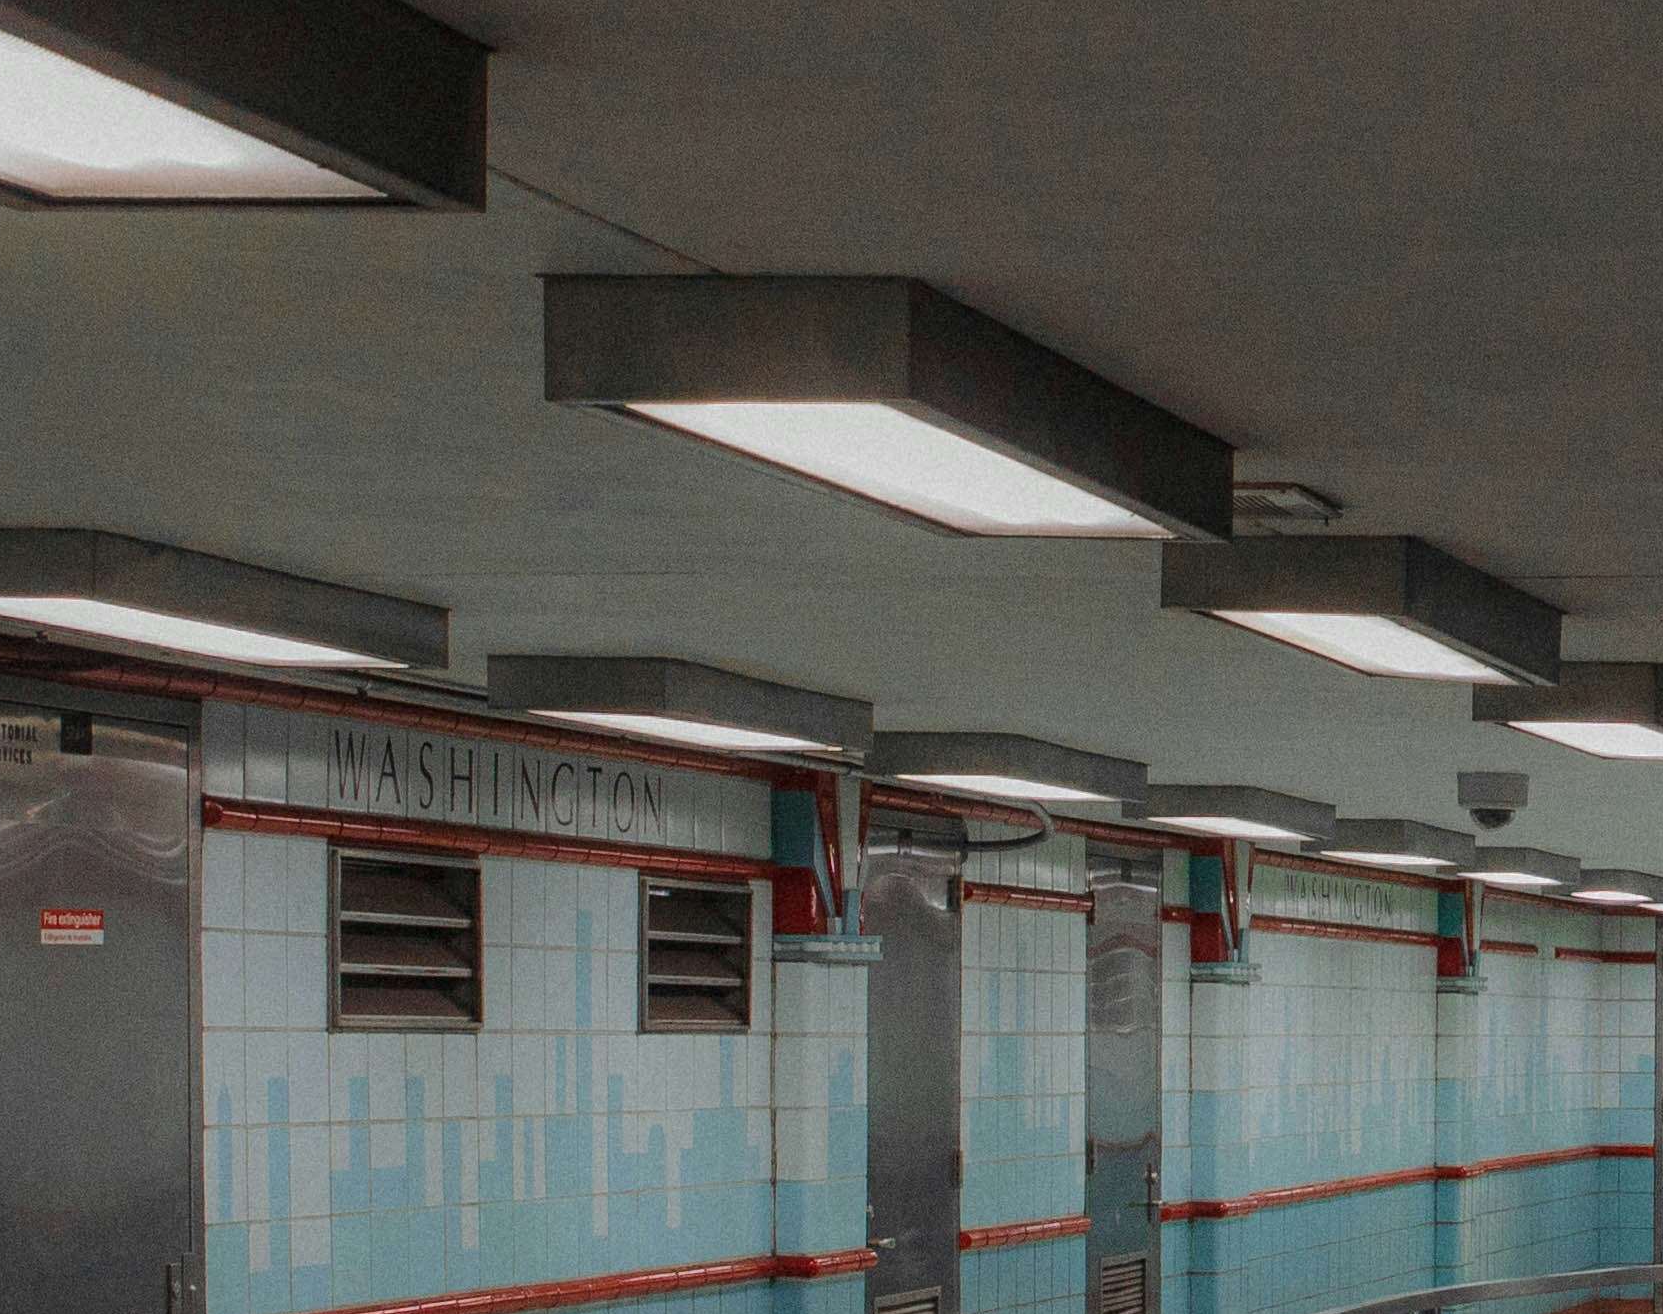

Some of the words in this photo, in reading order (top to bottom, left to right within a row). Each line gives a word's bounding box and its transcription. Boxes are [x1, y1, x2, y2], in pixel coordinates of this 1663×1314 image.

[333, 728, 665, 837] WASHINGTON
[43, 911, 57, 925] Fire
[58, 911, 102, 929] extinguisher
[1284, 873, 1395, 923] WASHINGTON
